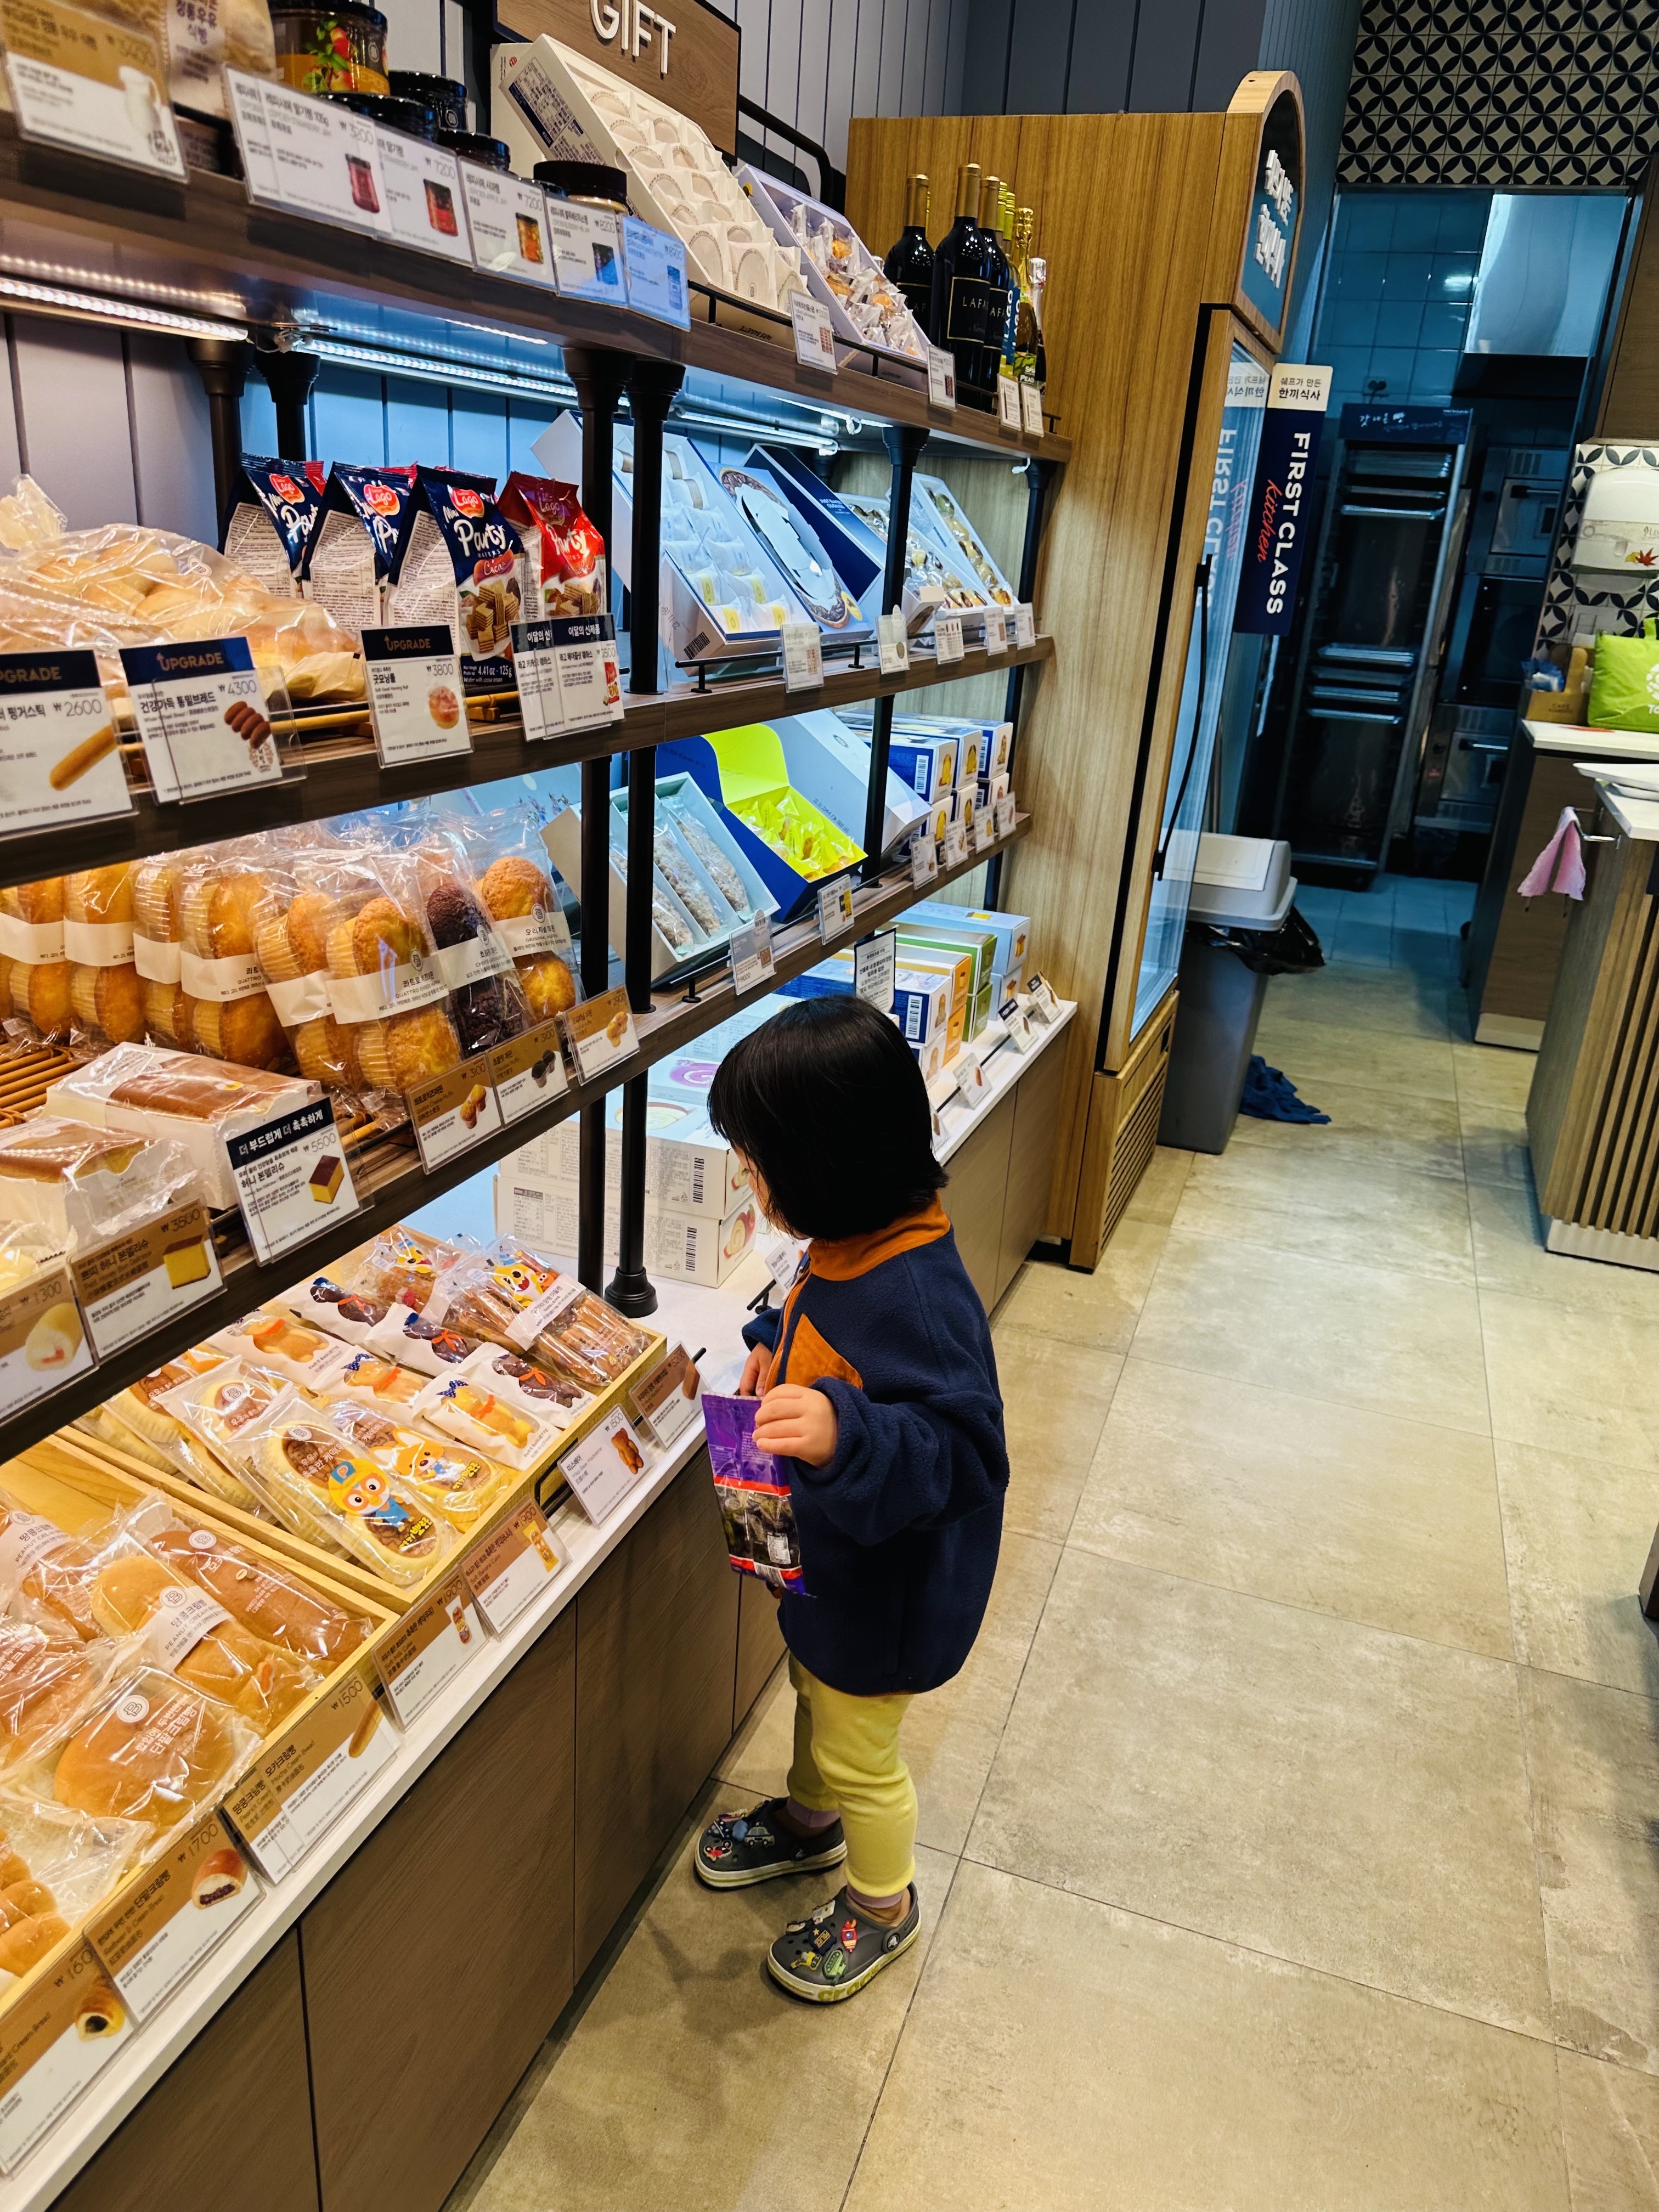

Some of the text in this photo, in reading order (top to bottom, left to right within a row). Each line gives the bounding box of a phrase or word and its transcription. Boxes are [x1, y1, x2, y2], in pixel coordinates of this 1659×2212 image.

[590, 0, 676, 76] GIFT
[1306, 377, 1322, 388] 만든
[1278, 387, 1321, 402] 한끼식사
[275, 481, 295, 493] Lago
[368, 488, 392, 504] Lago
[453, 493, 479, 507] Lago
[538, 497, 560, 513] Lago
[1266, 432, 1311, 615] FIRST CLASS
[453, 518, 506, 557] Party
[545, 523, 587, 556] Party
[527, 630, 545, 644] 이달의
[568, 624, 601, 636] 이달의 신제품
[385, 635, 432, 652] UPGRADE
[156, 651, 224, 672] UPGRADE
[432, 663, 454, 677] 3800
[227, 679, 257, 696] 4300
[373, 673, 397, 685] 굿모닝롤
[64, 698, 103, 717] 2600
[139, 691, 217, 713] 건강가득 통밀브레드
[237, 975, 262, 985] QUATTRO
[246, 966, 263, 975] 콰트
[402, 977, 421, 988] 콰트로
[395, 988, 419, 999] QUATTRO
[540, 1028, 555, 1043] 3100
[469, 1063, 486, 1079] 3100
[239, 1109, 324, 1156] 더 부드럽게 더 촉촉하게
[311, 1131, 337, 1153] 5500
[240, 1175, 258, 1189] 허니
[171, 1207, 201, 1232] 3500
[99, 1254, 118, 1272] 허니
[34, 1280, 63, 1305] 1300
[307, 1344, 340, 1370] PARIS BAGUETTE
[607, 1412, 625, 1429] 1500
[522, 1427, 551, 1458] PARIS BAGUETTE
[12, 1538, 40, 1563] PEANUT
[169, 1596, 207, 1629] 땅콩크림빵
[161, 1623, 192, 1650] PEANUT
[132, 1724, 164, 1754] 한입에
[143, 1703, 202, 1758] 단팥크림빵
[260, 1743, 300, 1778] 모카크림빵
[184, 1821, 223, 1857] 1700
[129, 1867, 176, 1909] 단팥크림빵
[63, 1948, 97, 1979] 160
[817, 1962, 879, 2002] crocs
